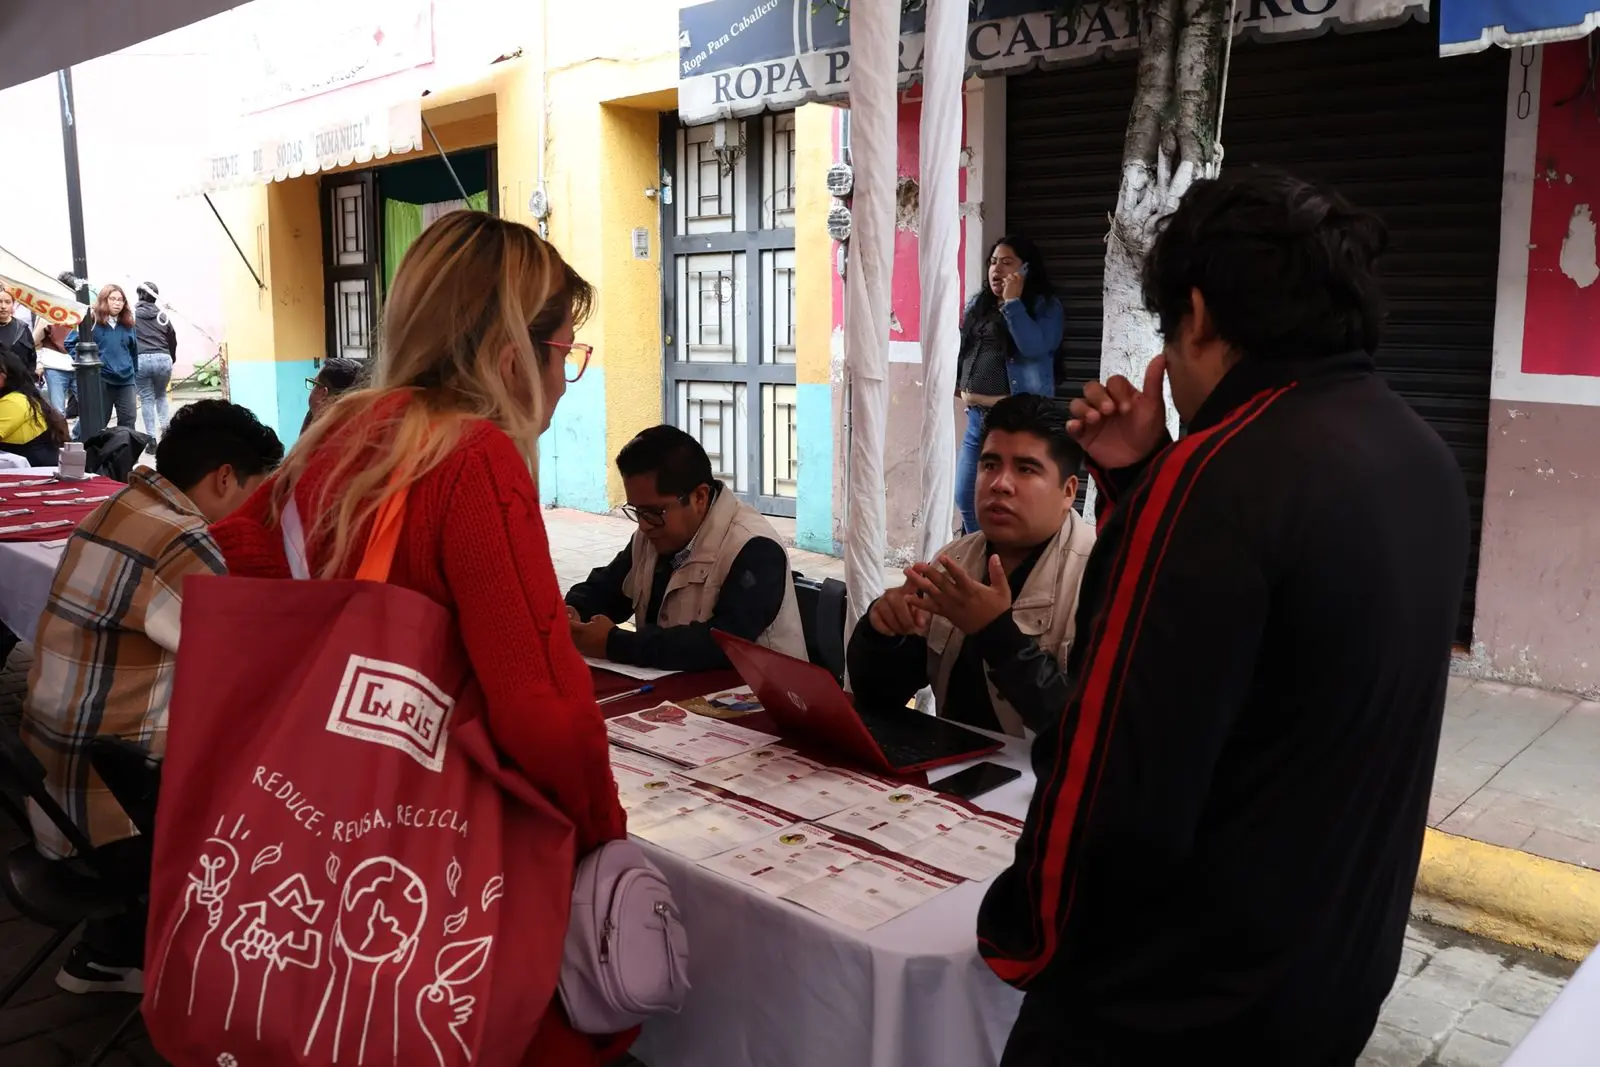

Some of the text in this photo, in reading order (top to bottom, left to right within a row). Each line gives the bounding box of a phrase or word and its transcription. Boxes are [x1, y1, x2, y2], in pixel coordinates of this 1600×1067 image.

[682, 0, 778, 74] Ropa Para Caballero
[712, 57, 812, 105] ROPA
[211, 153, 239, 181] FUENTE
[253, 149, 263, 172] DE
[276, 139, 303, 169] SODAS
[252, 765, 469, 843] REDUCE, REUSA, RECICLA
